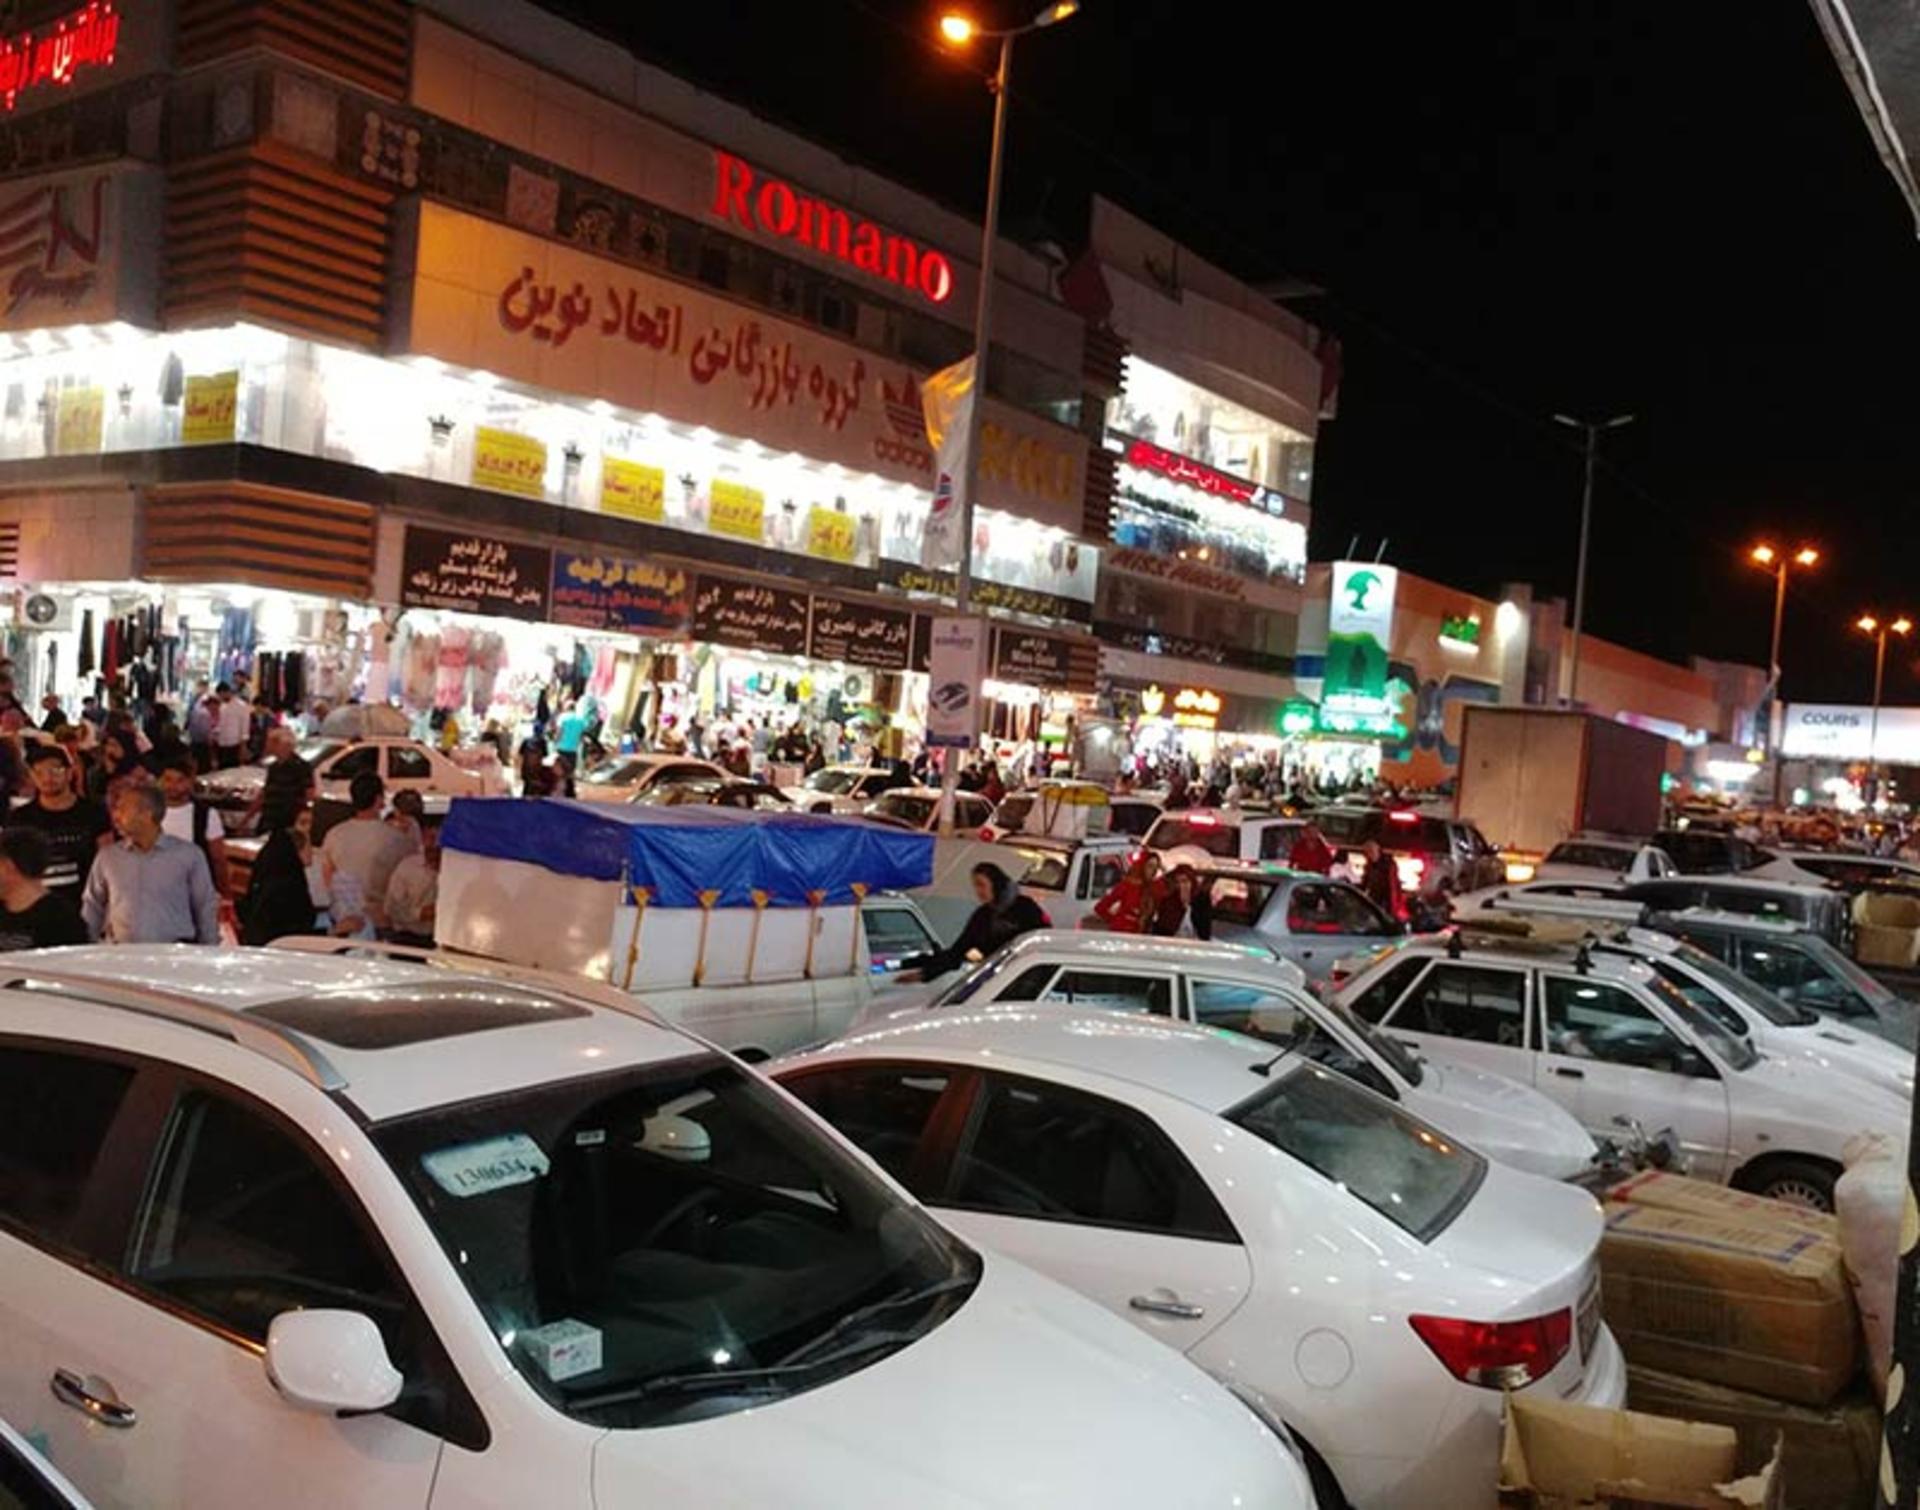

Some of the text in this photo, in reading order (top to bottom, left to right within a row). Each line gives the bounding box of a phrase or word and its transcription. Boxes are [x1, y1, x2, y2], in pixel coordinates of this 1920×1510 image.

[711, 151, 953, 302] Romano
[499, 266, 867, 432] گروه بازرگانی اتحاد نوین
